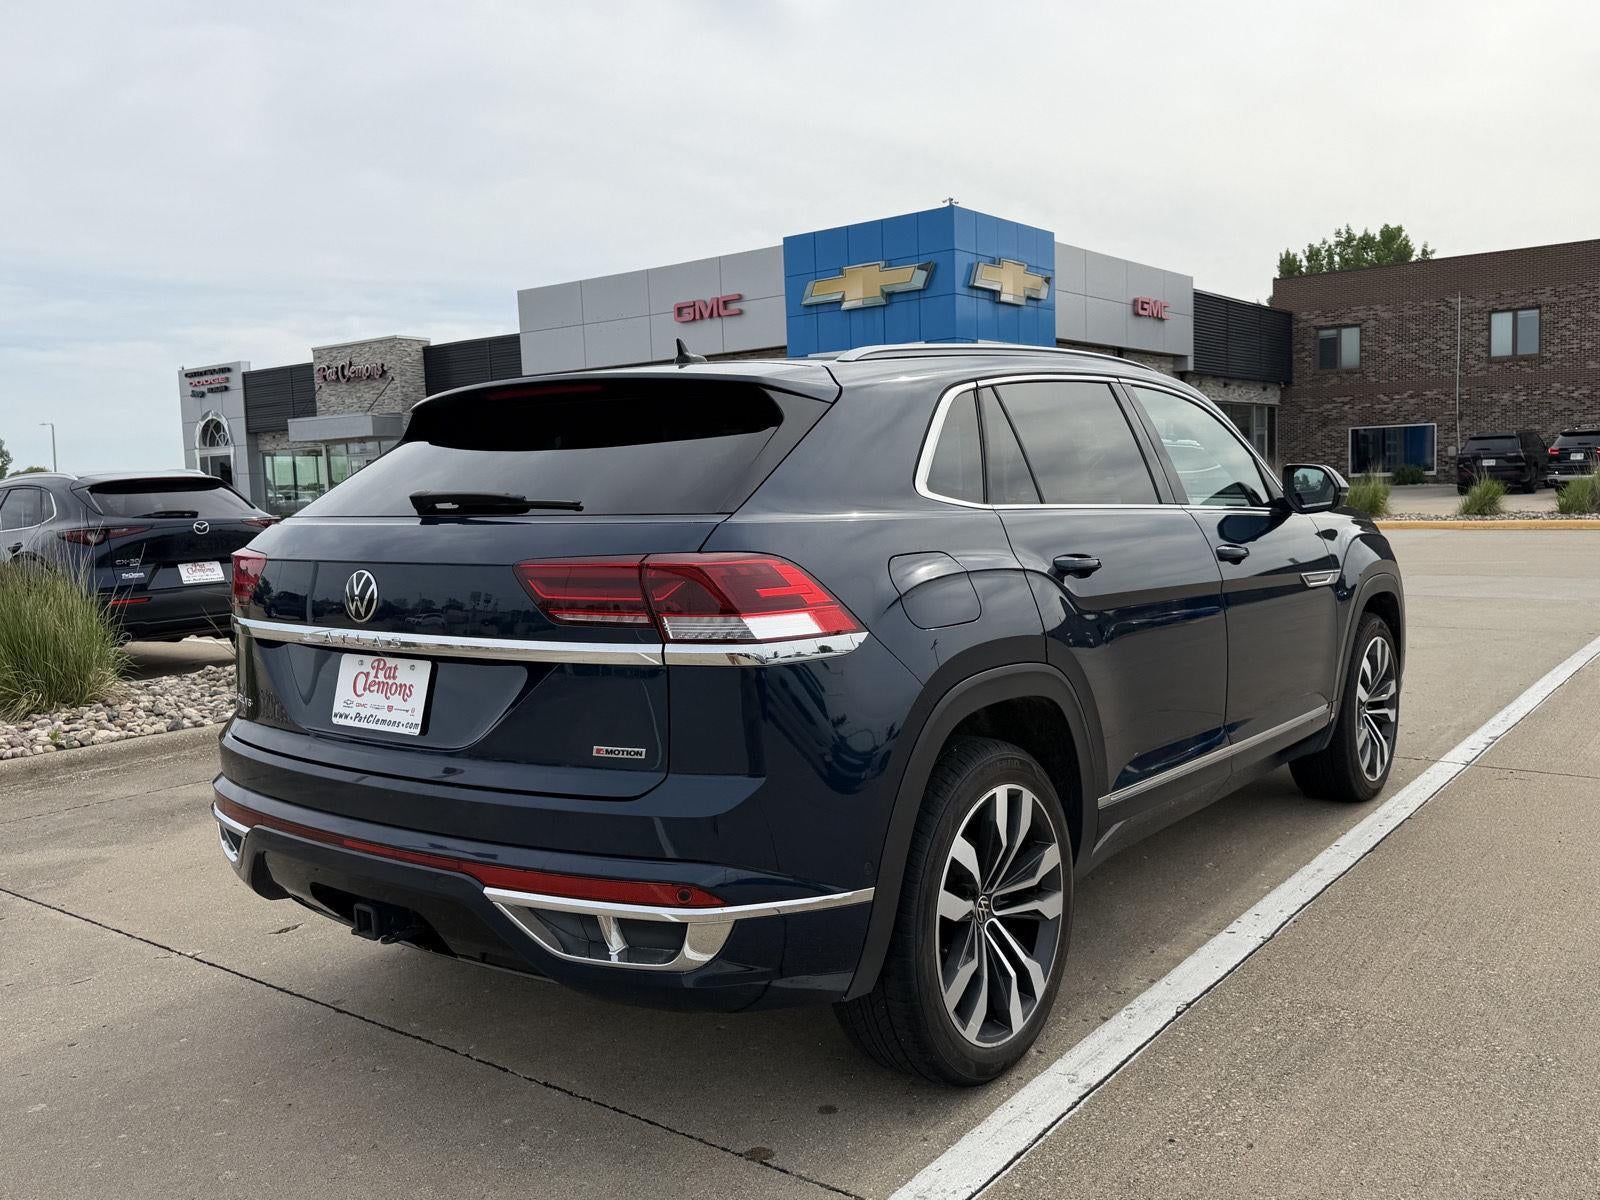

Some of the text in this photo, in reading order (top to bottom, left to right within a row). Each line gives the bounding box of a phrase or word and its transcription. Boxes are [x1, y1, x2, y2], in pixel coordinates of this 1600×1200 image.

[673, 293, 743, 323] GMC
[1134, 296, 1172, 321] GMC
[188, 376, 229, 388] DODGE
[316, 357, 384, 383] Pat Clemons
[370, 657, 399, 680] Pat
[352, 671, 414, 702] Clemons
